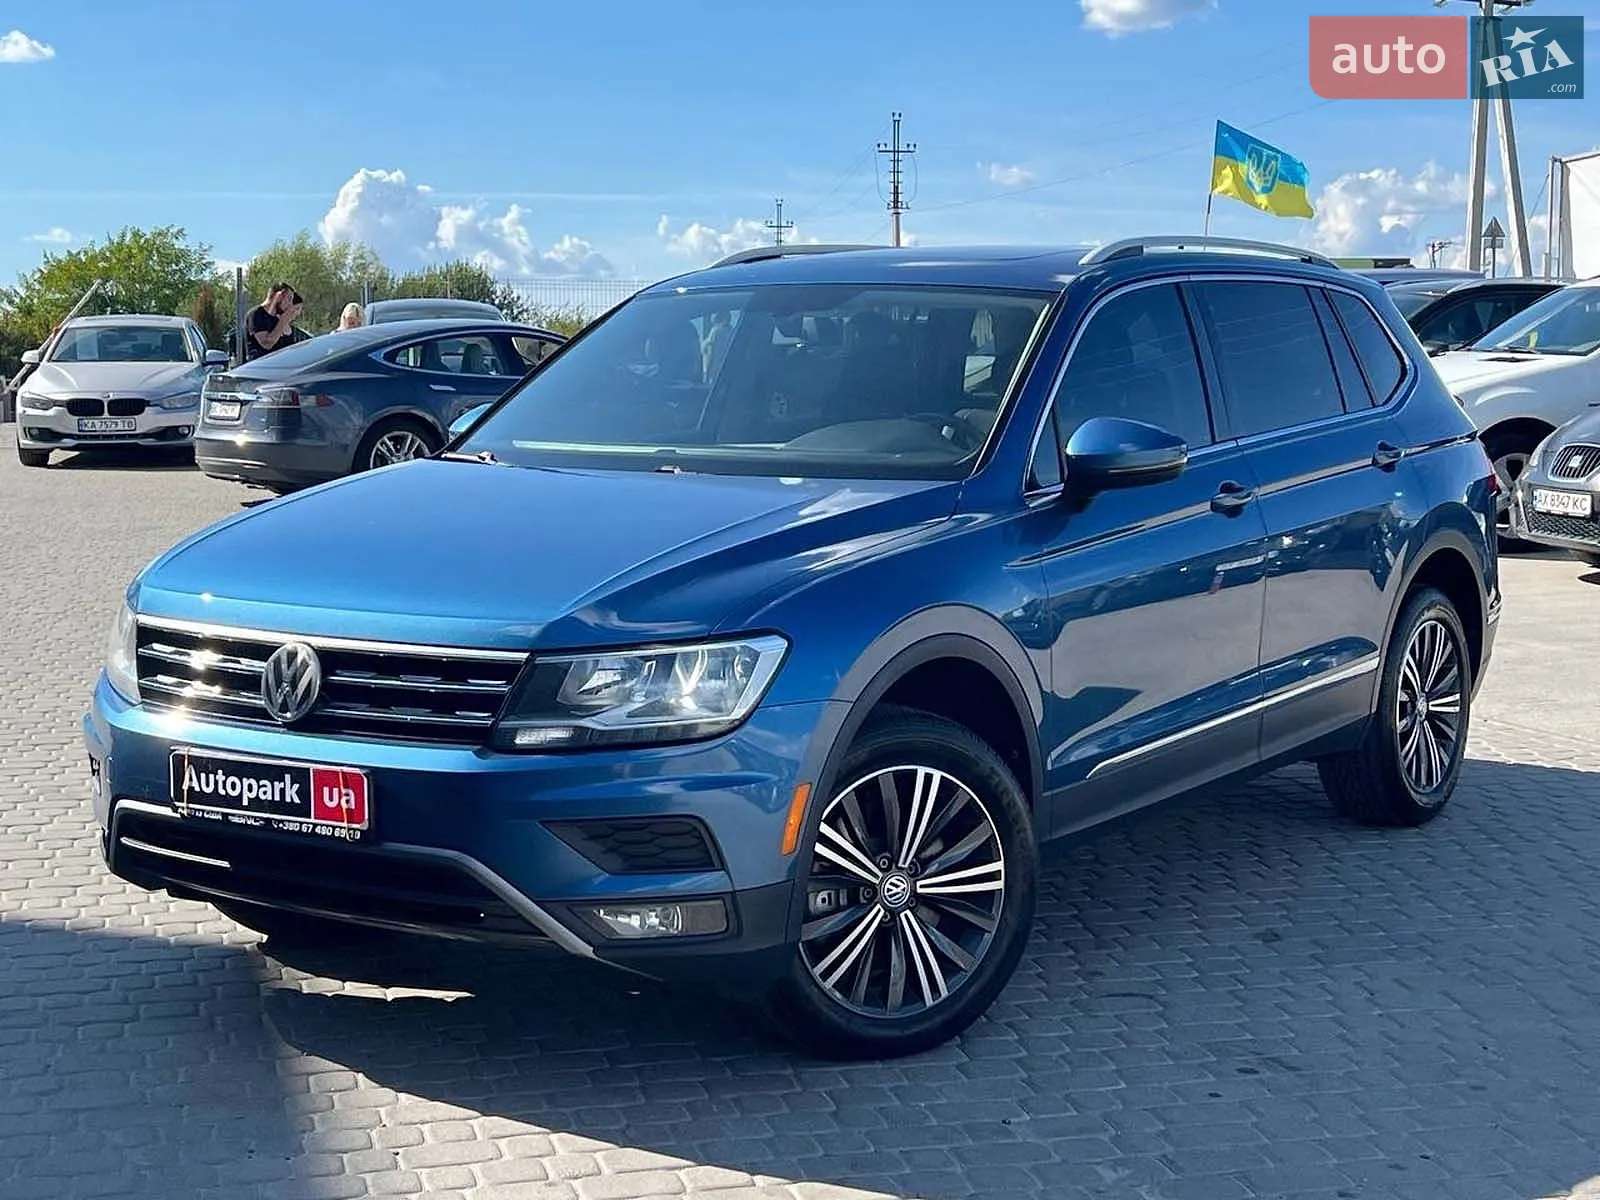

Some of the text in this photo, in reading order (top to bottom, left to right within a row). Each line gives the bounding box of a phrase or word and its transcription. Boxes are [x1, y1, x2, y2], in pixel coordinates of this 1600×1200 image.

[83, 420, 97, 429] KA
[1572, 496, 1587, 511] KC
[182, 764, 355, 809] Autopark ua
[302, 823, 313, 833] 67
